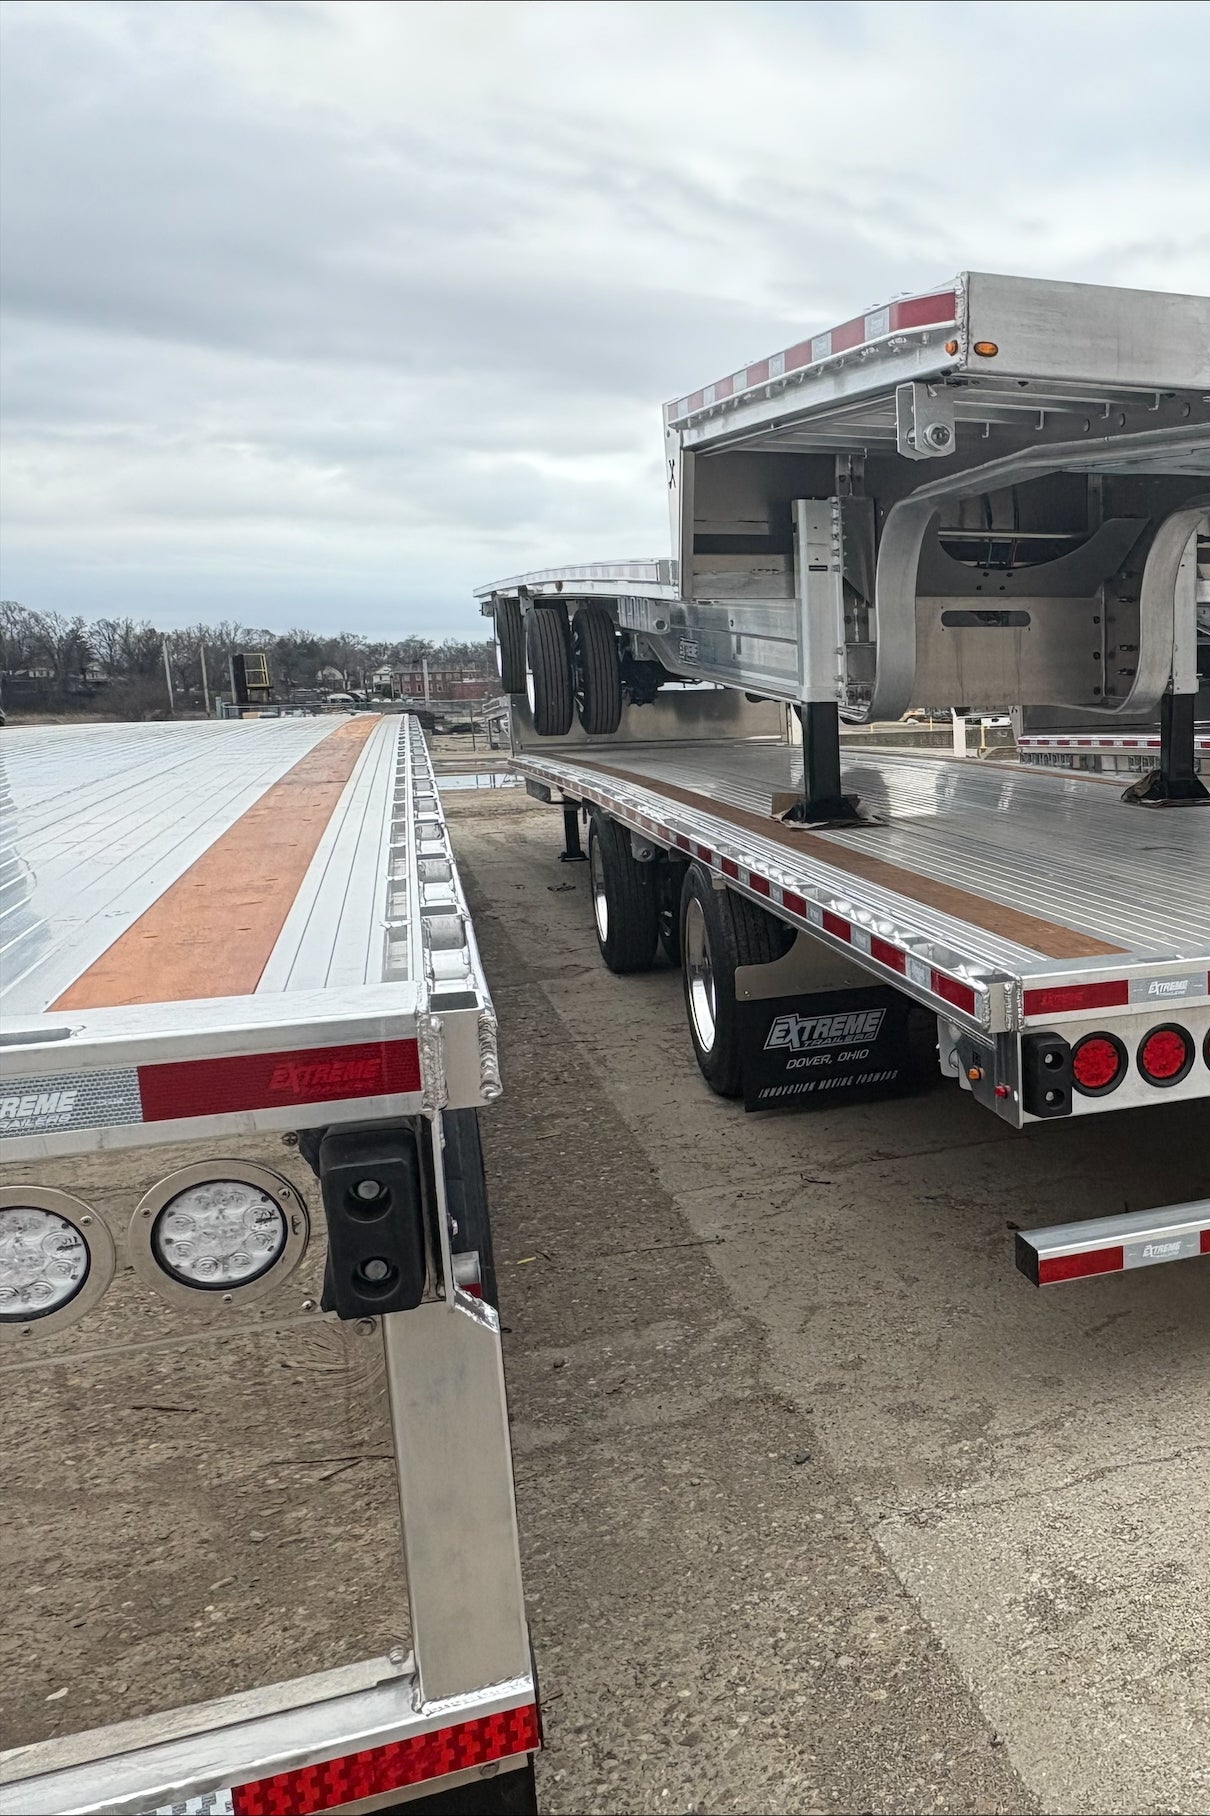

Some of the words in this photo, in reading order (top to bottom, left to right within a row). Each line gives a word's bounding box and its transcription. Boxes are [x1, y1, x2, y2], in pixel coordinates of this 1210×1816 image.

[1148, 980, 1188, 995] EXTREME
[769, 1011, 881, 1048] EXTREME
[803, 1032, 875, 1048] TRAILERS
[786, 1053, 832, 1070] DOVER,
[838, 1049, 869, 1061] OHIO
[268, 1058, 383, 1094] EXTREME
[0, 1091, 78, 1119] REME
[1142, 1241, 1182, 1257] EXTREME
